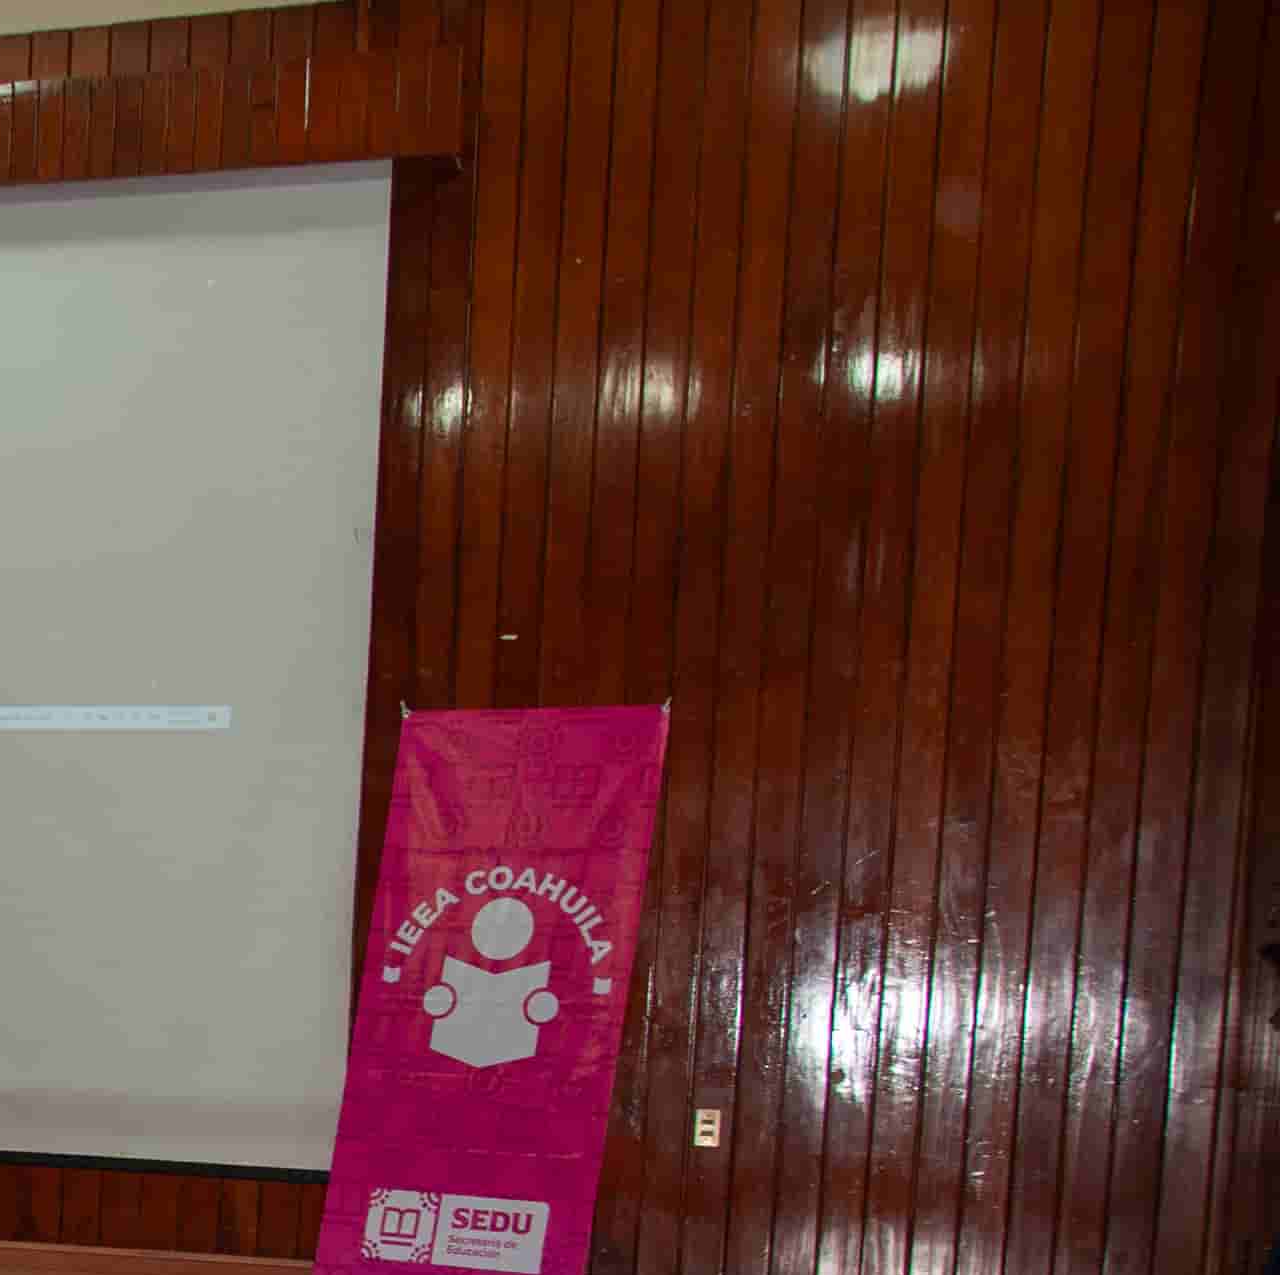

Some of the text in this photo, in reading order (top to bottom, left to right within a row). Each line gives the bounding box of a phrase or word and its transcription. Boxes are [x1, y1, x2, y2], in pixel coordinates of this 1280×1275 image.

[390, 866, 613, 965] IEEA COAHUILA
[451, 1207, 534, 1235] SEDU
